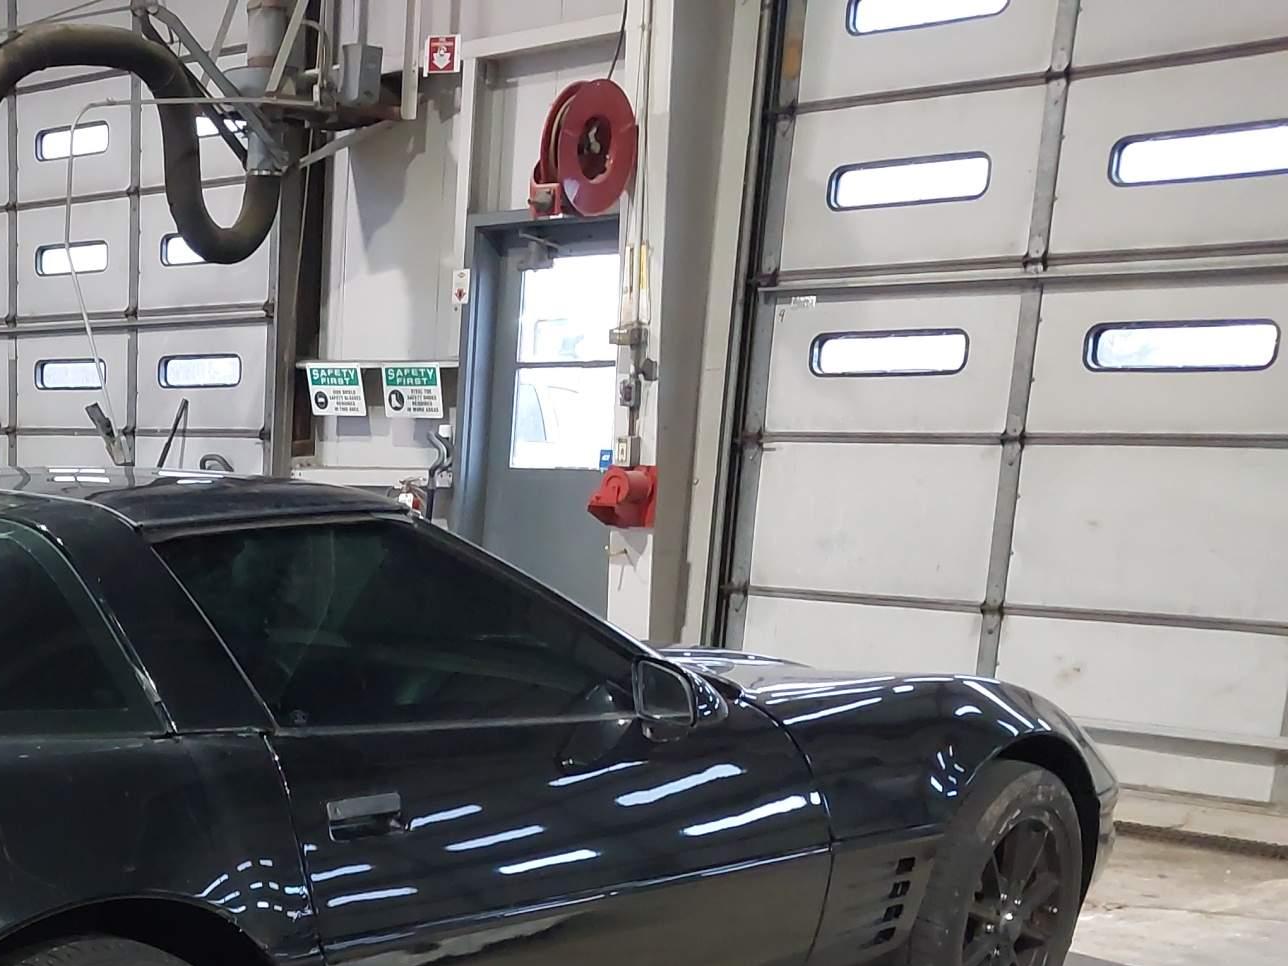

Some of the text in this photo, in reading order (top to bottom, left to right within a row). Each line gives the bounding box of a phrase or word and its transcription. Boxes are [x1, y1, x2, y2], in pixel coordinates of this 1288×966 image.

[312, 368, 355, 380] SAFETY
[388, 368, 434, 380] SAFETY
[320, 377, 350, 385] FIRST
[396, 377, 429, 385] FIRST
